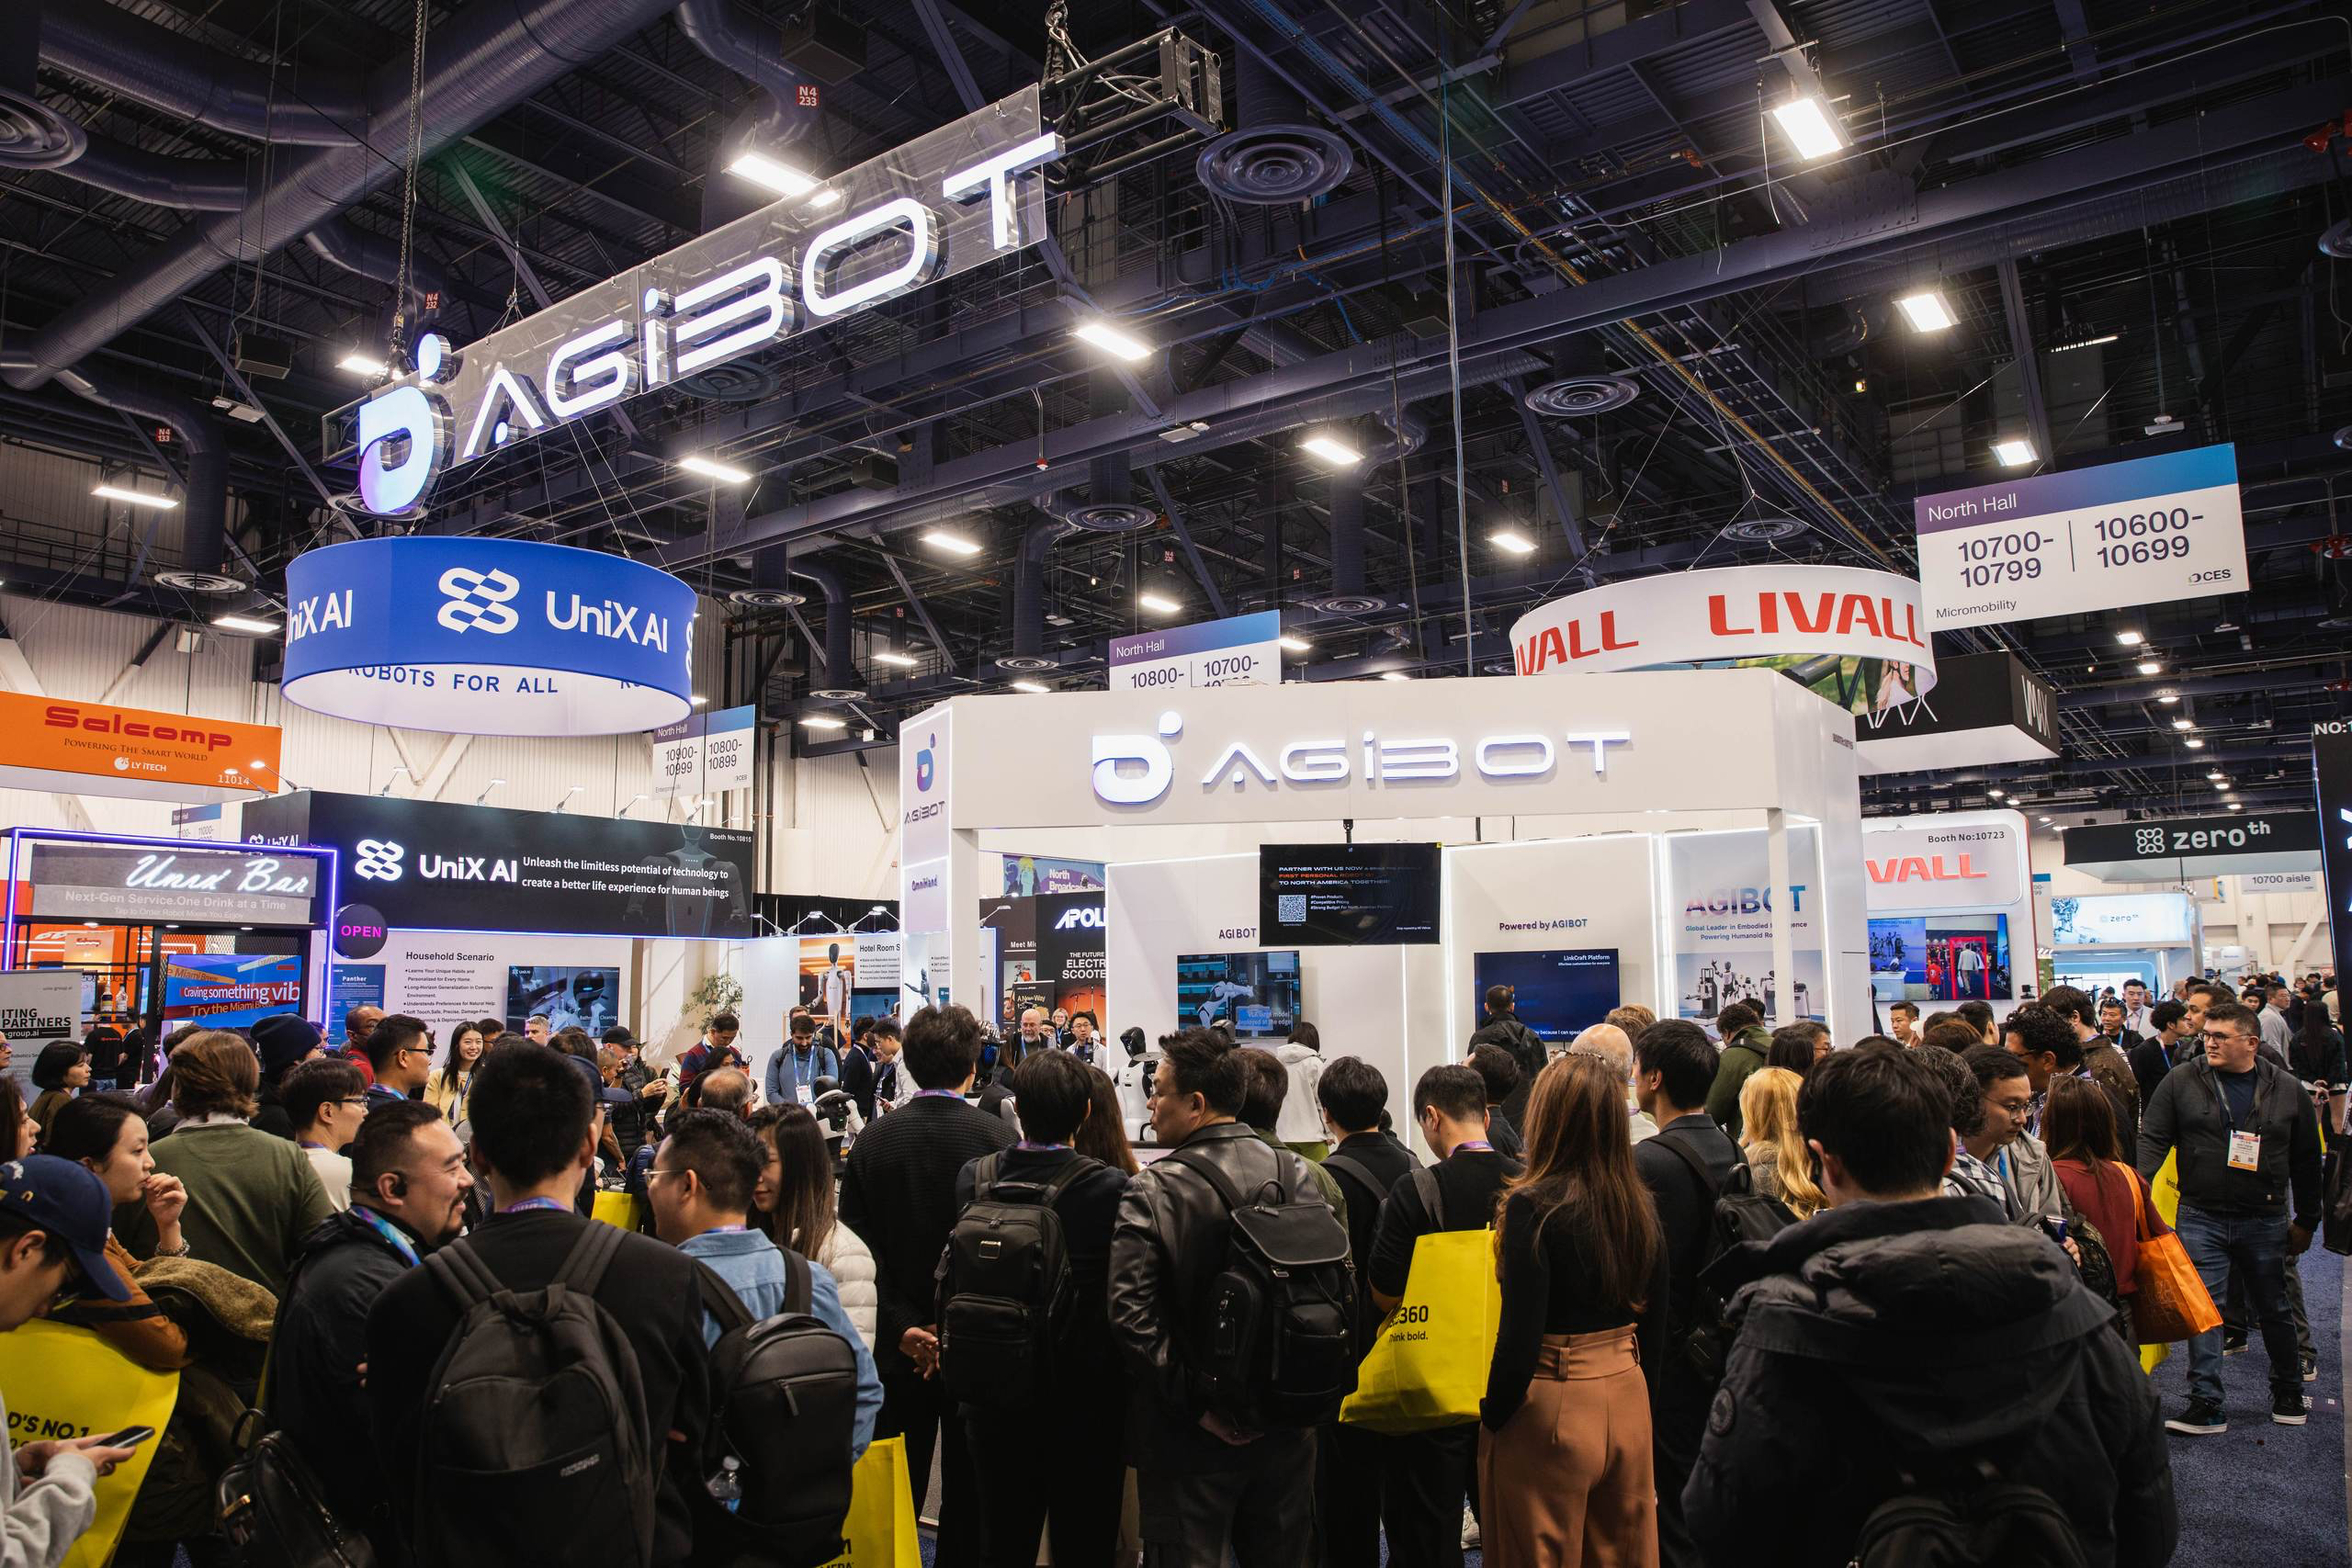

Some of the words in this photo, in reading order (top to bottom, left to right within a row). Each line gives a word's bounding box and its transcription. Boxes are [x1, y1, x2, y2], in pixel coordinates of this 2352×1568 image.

[799, 96, 817, 106] 233
[1928, 500, 1977, 522] North
[1983, 493, 2017, 512] Hall
[1958, 531, 2054, 562] 10700-
[2094, 507, 2204, 541] 10600-
[1960, 558, 2041, 588] 10799
[2097, 536, 2190, 568] 10699
[2203, 569, 2231, 581] CES
[321, 589, 353, 631] AI
[1936, 599, 2017, 618] Micromobility
[546, 590, 639, 644] UniX
[642, 611, 668, 654] AI
[1708, 592, 1925, 649] LIVALL
[1117, 643, 1143, 658] North
[1146, 639, 1165, 653] Hall
[1131, 667, 1184, 689] 10800-
[1204, 655, 1259, 677] 10700-
[453, 674, 500, 692] FOR
[516, 677, 558, 693] ALL
[45, 706, 232, 751] Salcomp
[657, 727, 675, 737] North
[676, 724, 688, 734] Hall
[709, 739, 742, 755] 10800-
[131, 761, 141, 770] LY
[665, 761, 692, 776] 10999
[708, 755, 736, 770] 10899
[218, 774, 250, 785] 11014
[1928, 833, 1956, 843] Booth
[1958, 830, 2005, 841] No:10723
[237, 857, 309, 893] Bar
[418, 853, 485, 881] UniX
[489, 859, 518, 883] AI
[523, 856, 561, 868] Unleash
[563, 858, 579, 869] the
[581, 860, 619, 872] limitless
[621, 864, 660, 875] potential
[662, 866, 673, 875] of
[673, 867, 718, 880] technology
[720, 870, 728, 879] to
[1049, 869, 1070, 879] North
[1865, 853, 1989, 883] VALL
[912, 875, 938, 891] OmniHand
[2252, 875, 2283, 884] 10700
[2286, 874, 2311, 883] aisle
[522, 878, 552, 888] create
[562, 879, 590, 890] better
[592, 881, 606, 891] life
[608, 883, 656, 894] experience
[658, 885, 671, 894] for
[672, 886, 701, 896] human
[702, 887, 729, 899] beings
[66, 891, 124, 903] Next-Gen
[128, 894, 200, 907] Service.One
[204, 897, 233, 908] Drink
[237, 899, 247, 908] at
[261, 899, 286, 910] Time
[341, 925, 381, 937] OPEN
[1219, 928, 1256, 939] AGIBOT
[1499, 921, 1537, 931] Powered
[1539, 921, 1550, 930] by
[1552, 919, 1587, 928] AGIBOT
[406, 951, 454, 961] Household
[457, 953, 494, 961] Scenario
[175, 968, 201, 980] Miami
[184, 987, 208, 1000] Craving
[209, 985, 270, 1004] something
[2, 1009, 37, 1018] ITING
[190, 1005, 209, 1018] Try
[212, 1004, 228, 1014] the
[230, 1002, 255, 1011] Miami
[2, 1017, 71, 1028] PARTNERS
[1407, 1331, 1428, 1341] bold.
